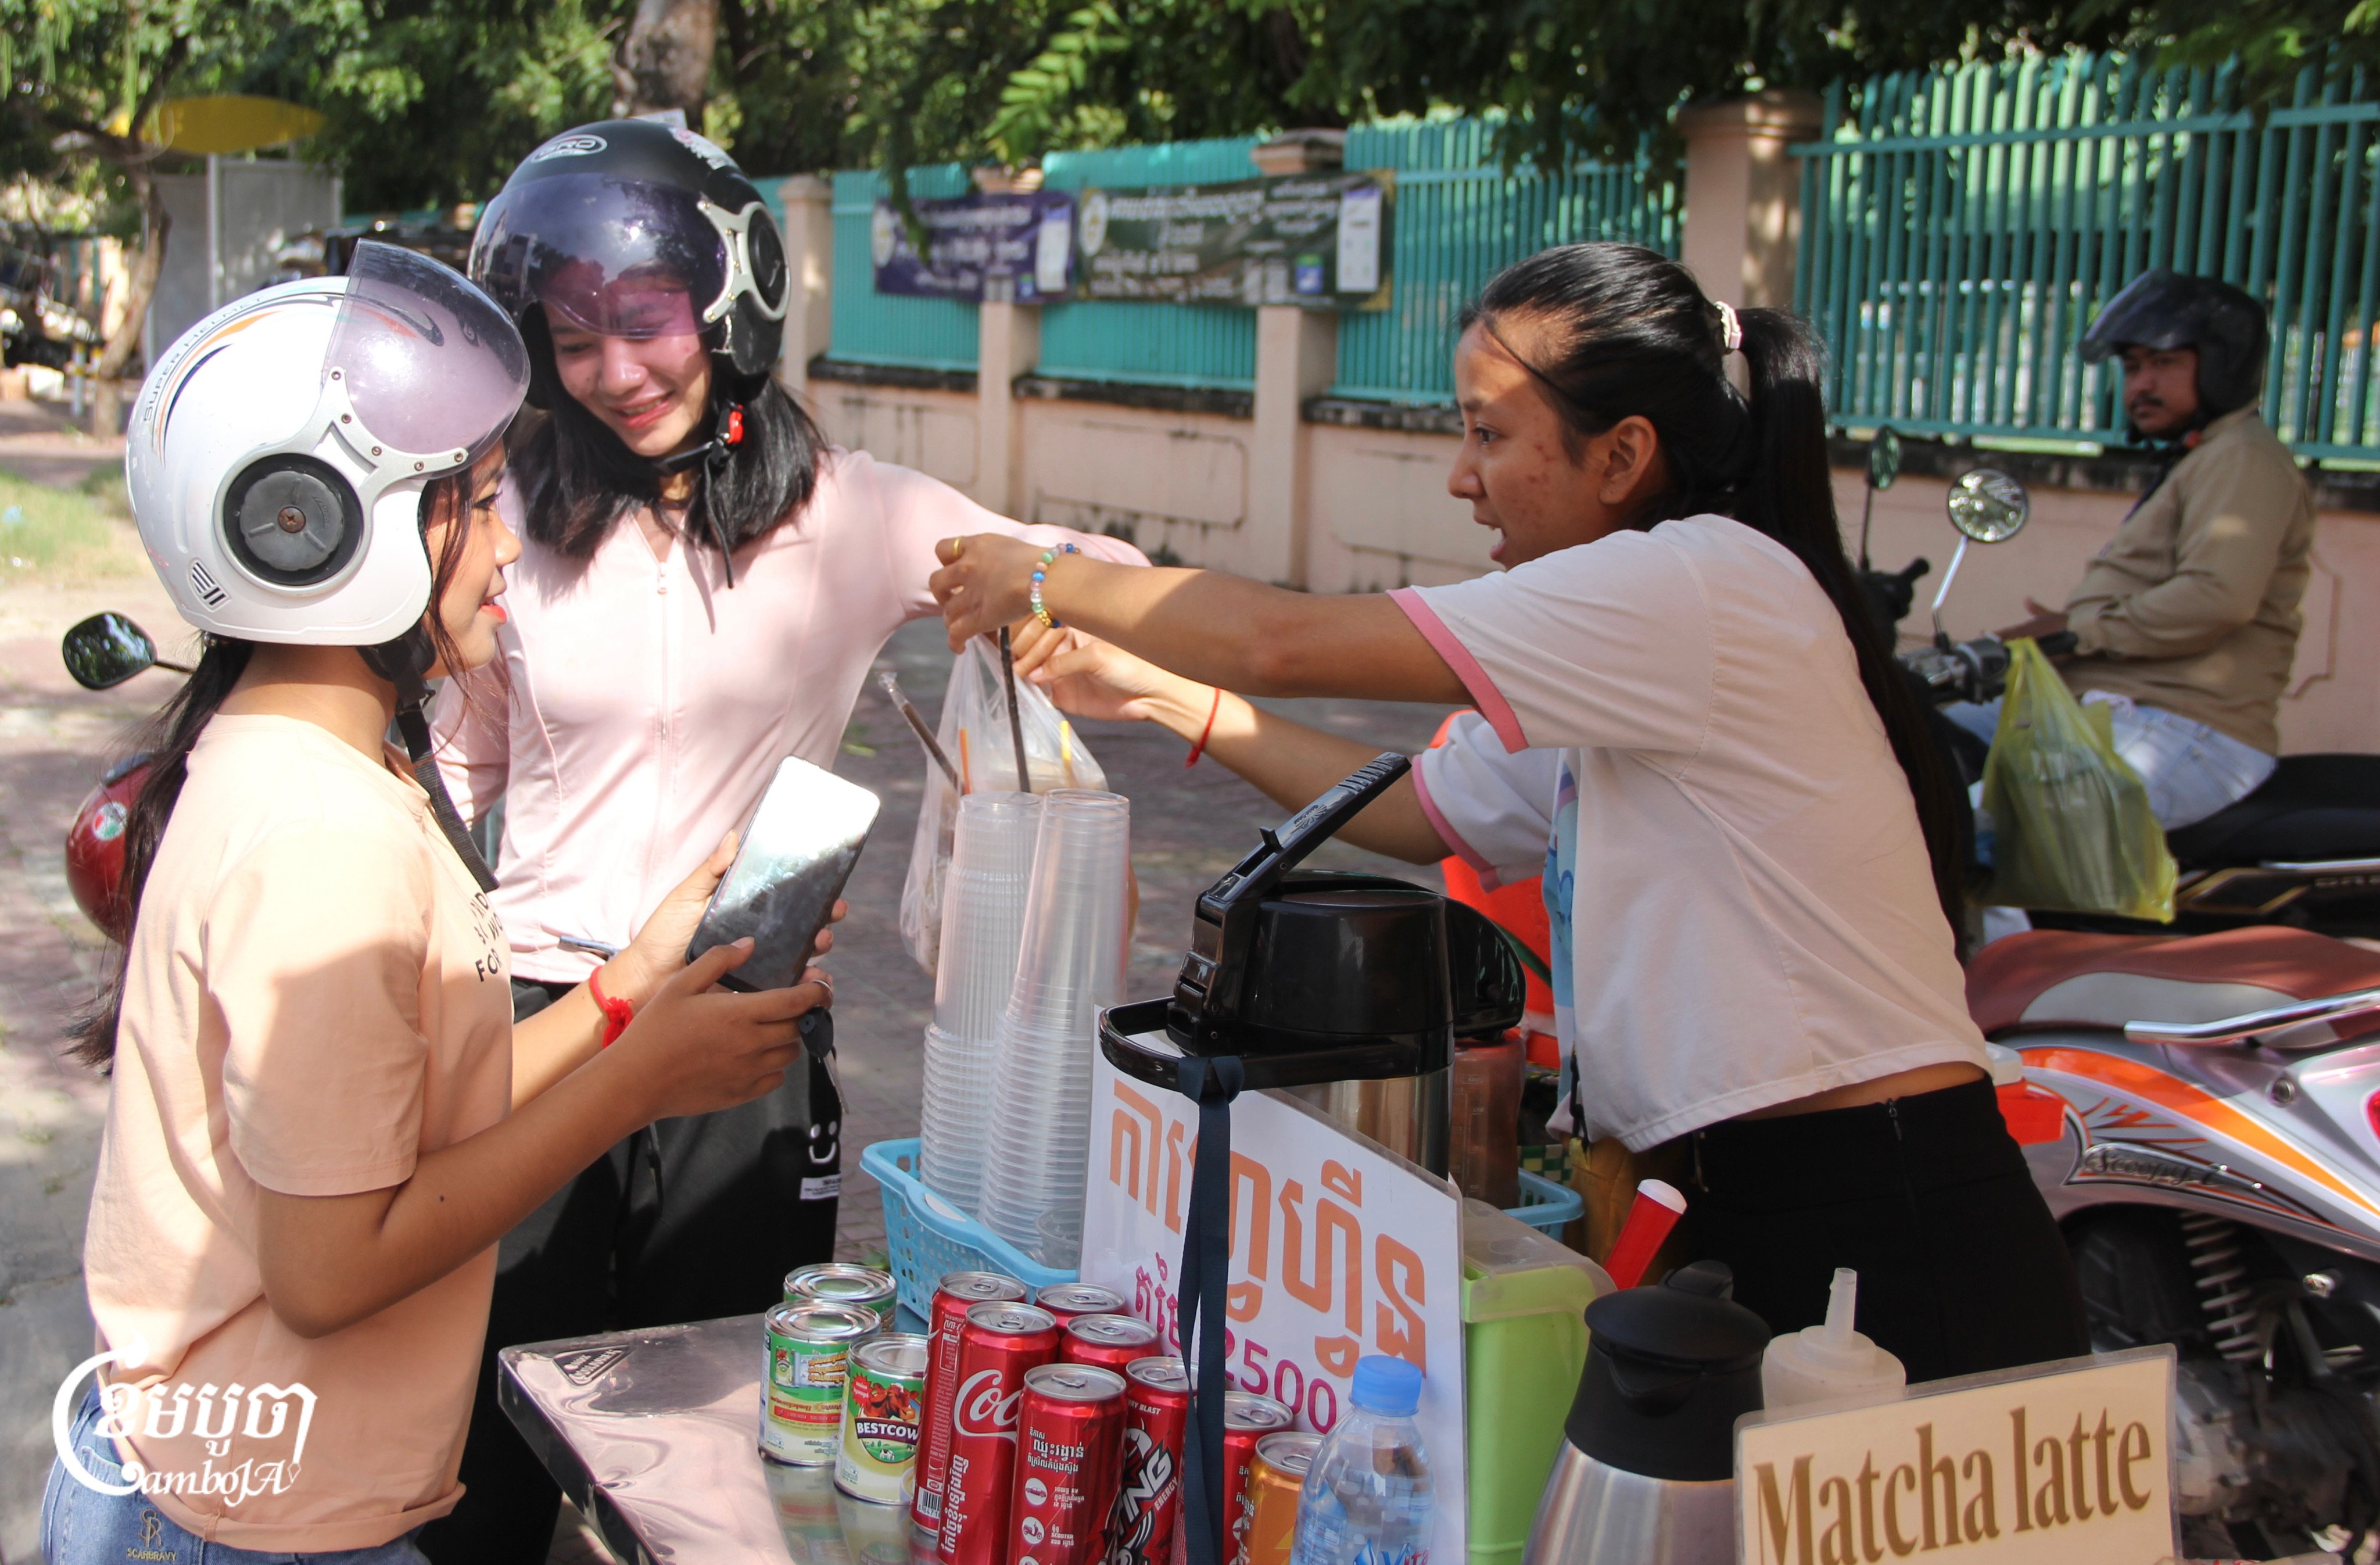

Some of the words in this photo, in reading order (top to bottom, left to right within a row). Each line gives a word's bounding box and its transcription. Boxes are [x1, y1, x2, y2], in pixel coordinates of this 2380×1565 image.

[475, 948, 503, 983] FOR
[1139, 1403, 1162, 1414] BLAST
[856, 1422, 919, 1441] BESTCOW
[1115, 1448, 1173, 1537] ING
[1153, 1476, 1178, 1512] ENERGY
[1752, 1422, 2000, 1565] Matcha
[2010, 1405, 2152, 1533] latte
